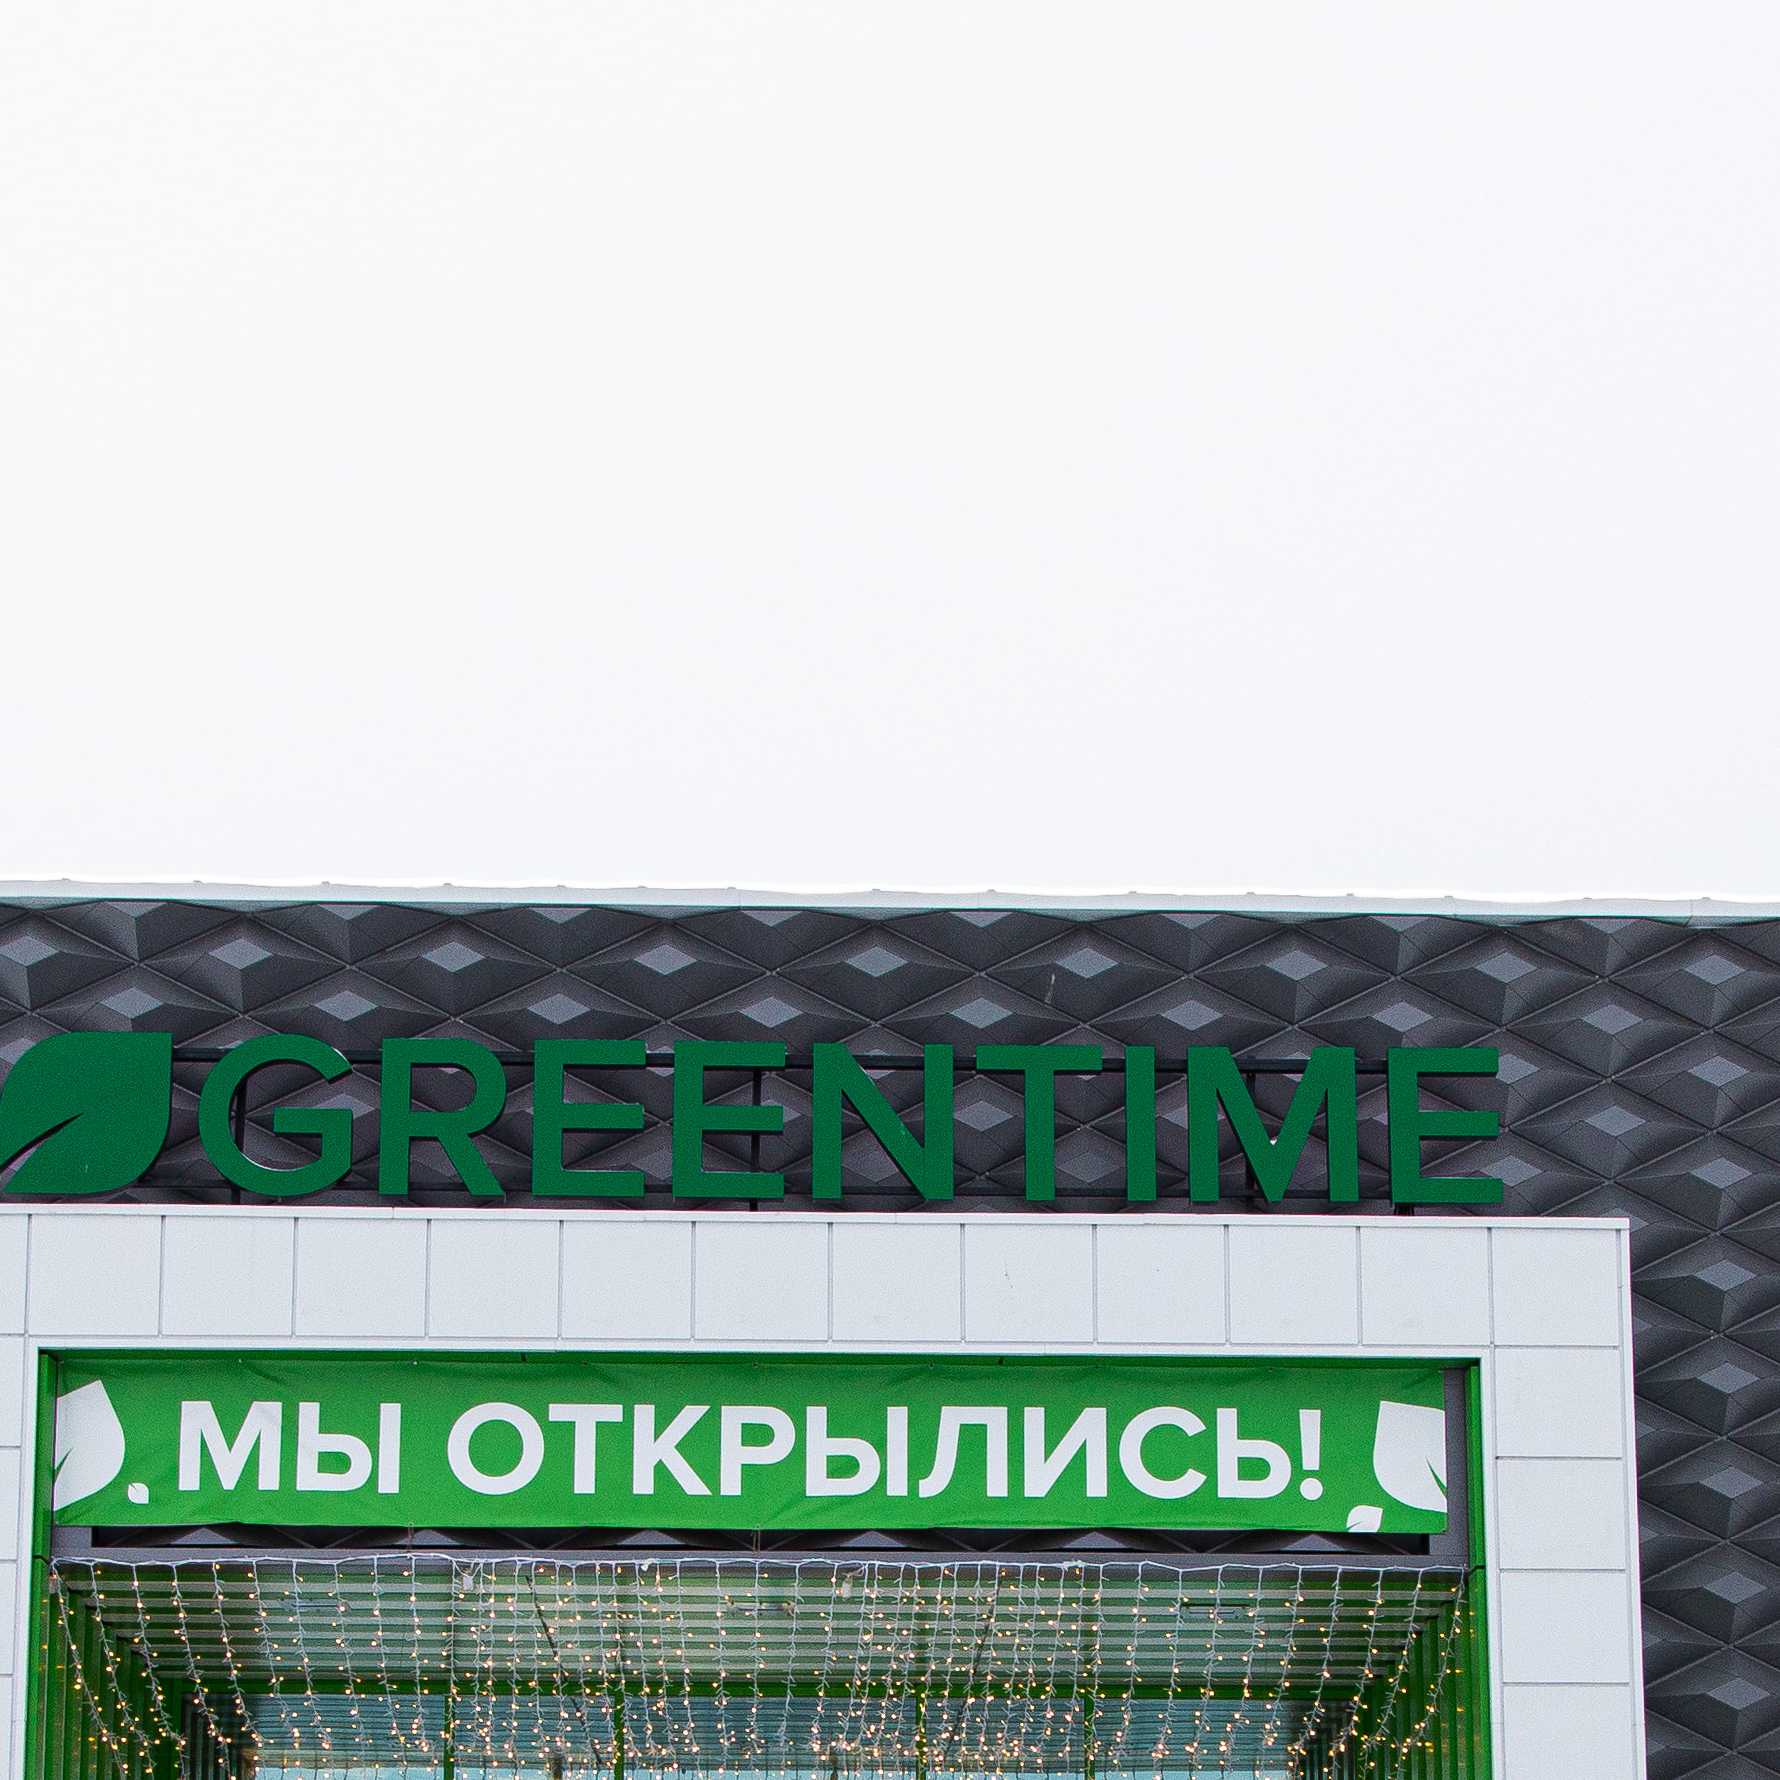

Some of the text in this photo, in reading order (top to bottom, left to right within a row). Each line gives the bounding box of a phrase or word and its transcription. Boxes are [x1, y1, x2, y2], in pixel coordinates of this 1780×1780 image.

[198, 1032, 1504, 1205] GREENTIME
[177, 1400, 1324, 1501] МЫ ОТКРЫЛИСЬ!
